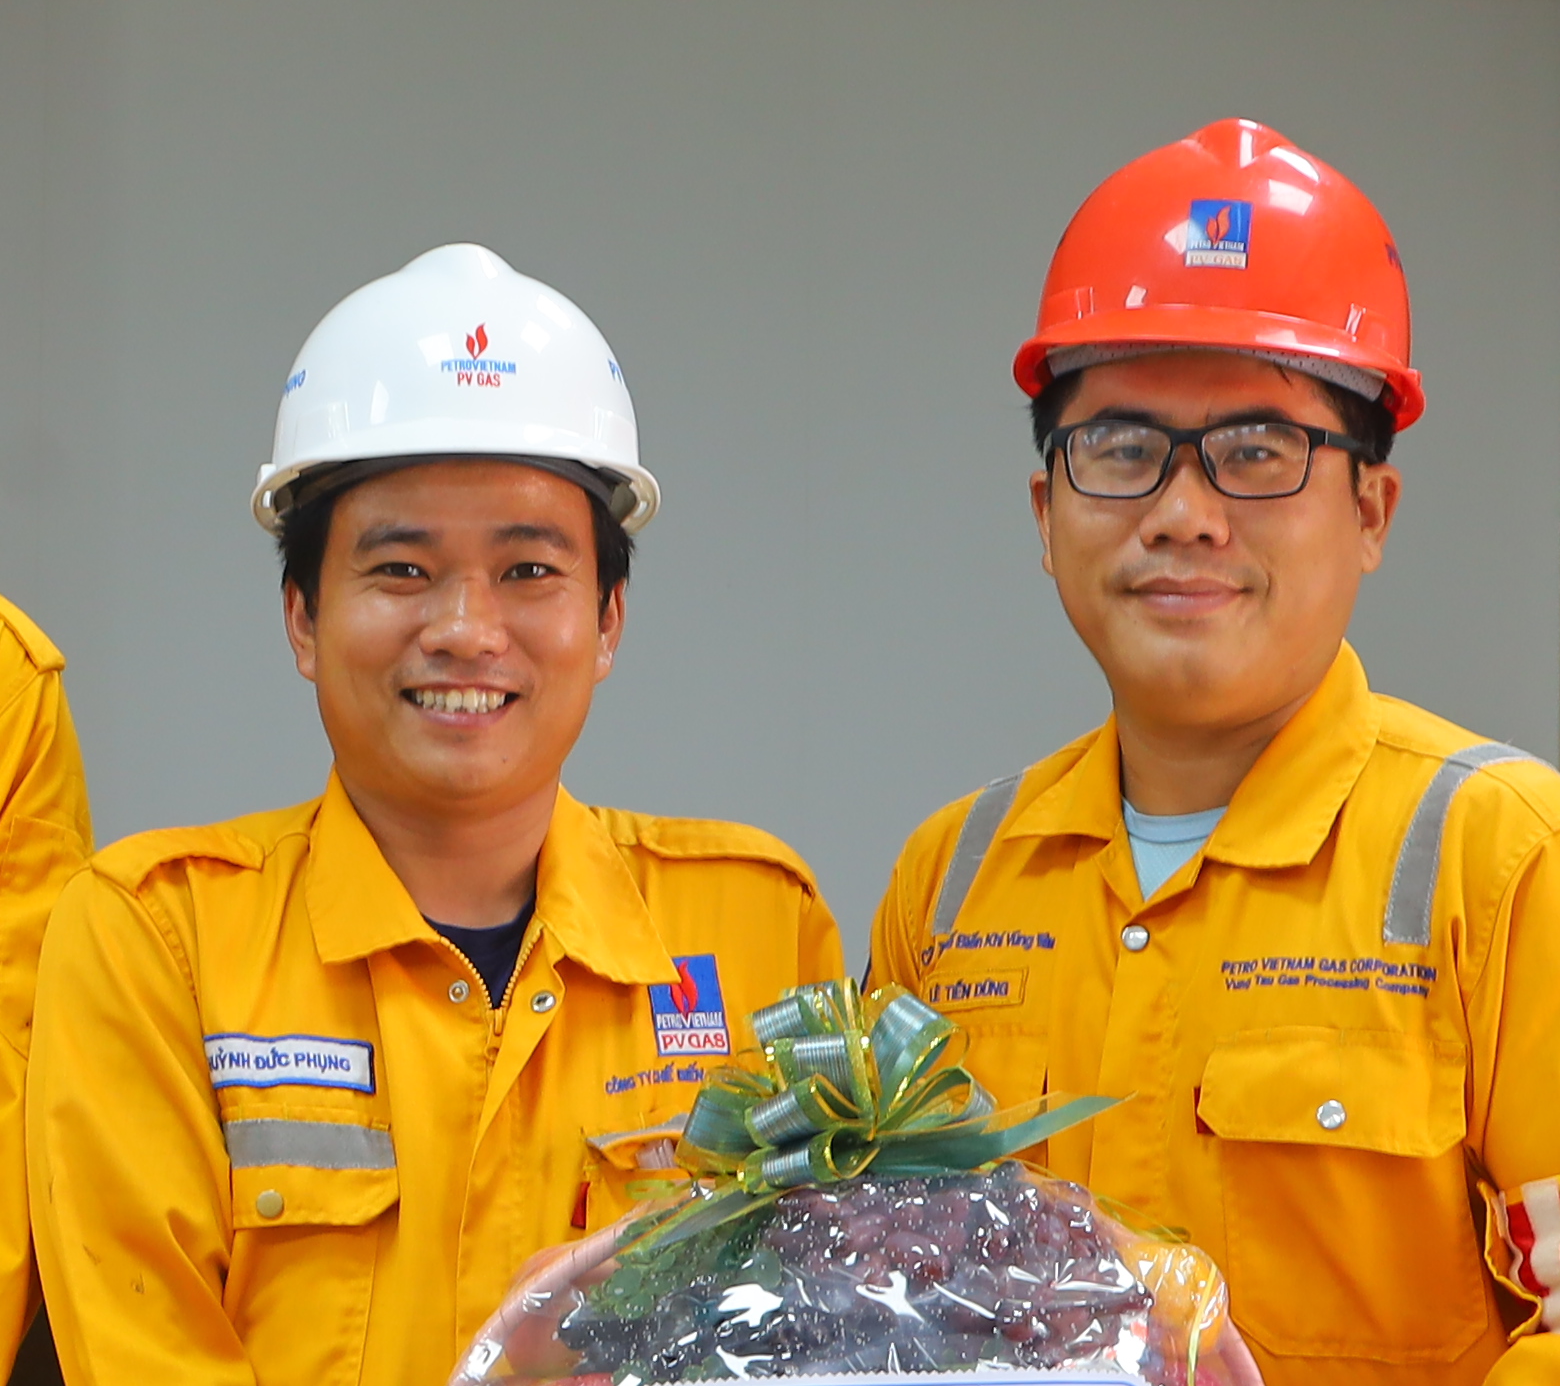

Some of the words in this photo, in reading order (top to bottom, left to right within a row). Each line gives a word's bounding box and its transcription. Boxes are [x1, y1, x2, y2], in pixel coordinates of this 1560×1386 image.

[441, 358, 517, 375] PETROVIETNAM
[457, 372, 472, 387] PV
[477, 373, 501, 388] GAS
[1221, 959, 1258, 976] PETRO
[1262, 957, 1315, 972] VIETNAM
[1319, 958, 1347, 974] GAS
[1351, 958, 1437, 982] CORPORATION
[661, 1033, 685, 1050] PV
[254, 1046, 291, 1069] ĐỨC
[294, 1051, 352, 1073] PHỤNG
